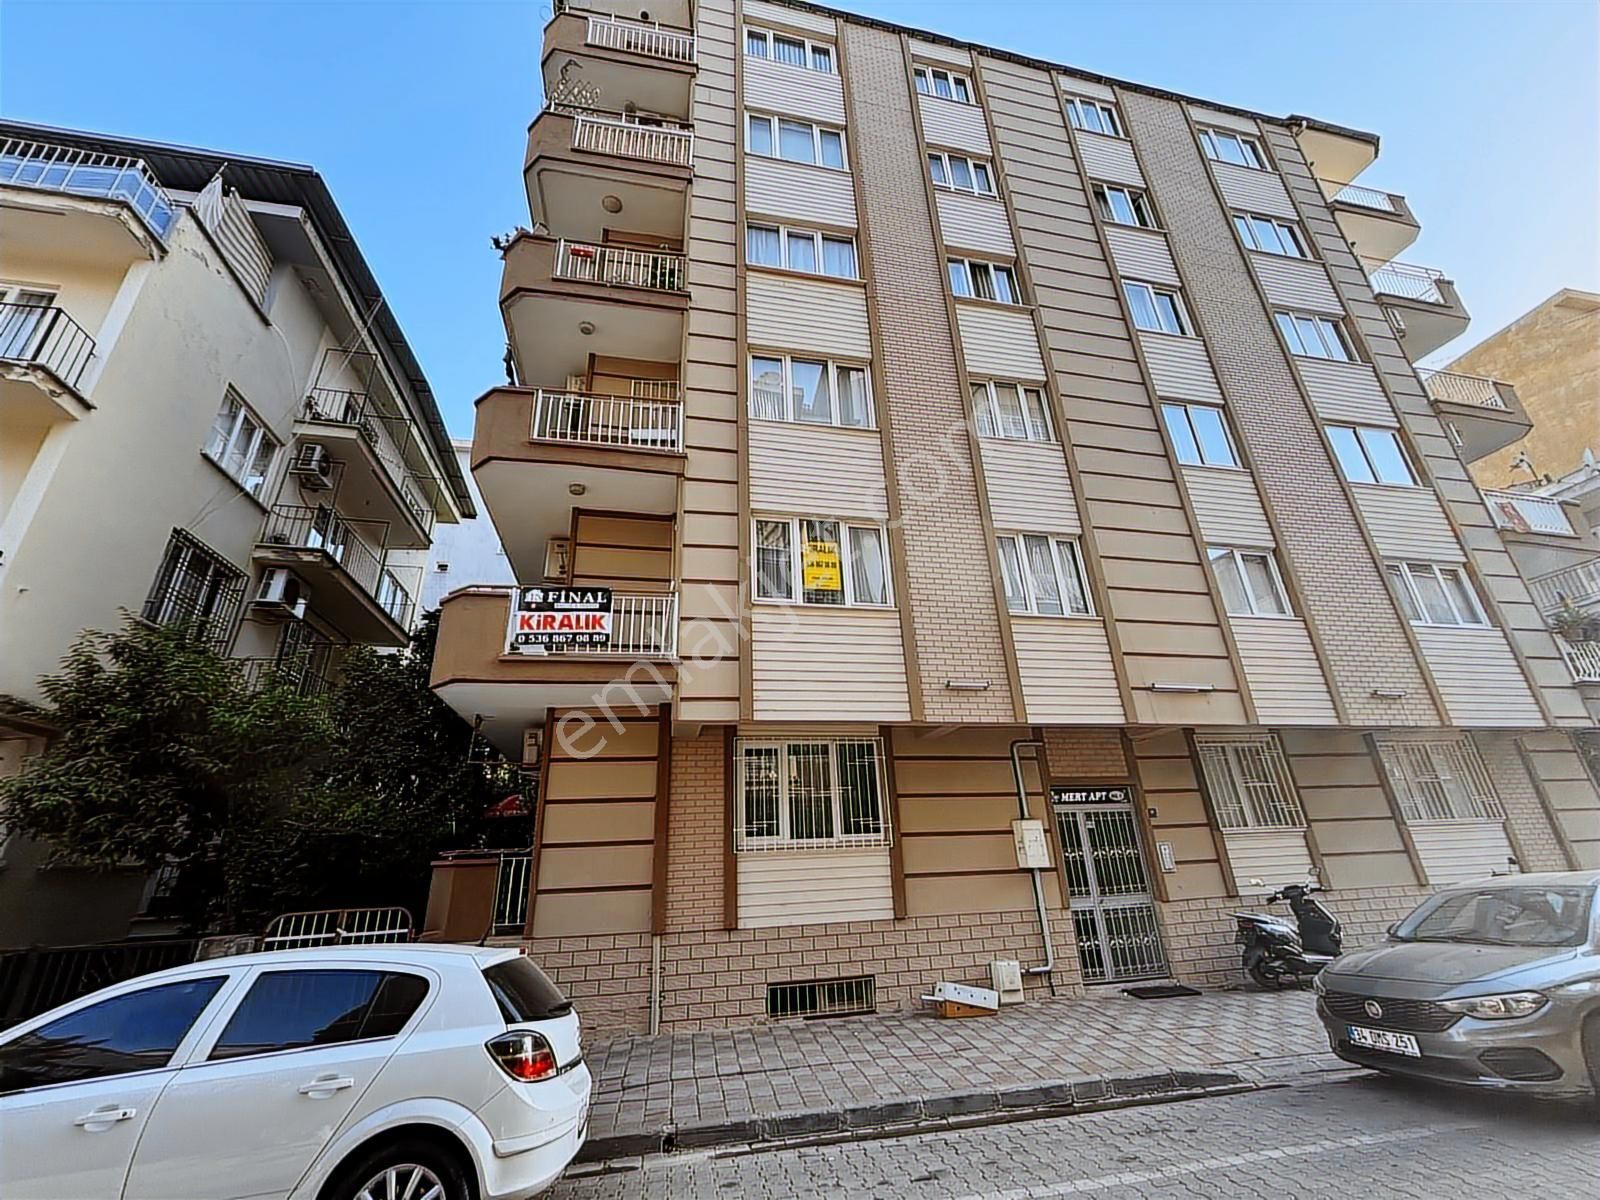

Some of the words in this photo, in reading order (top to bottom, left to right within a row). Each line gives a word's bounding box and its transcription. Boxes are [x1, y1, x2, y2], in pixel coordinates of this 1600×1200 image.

[518, 634, 525, 643] 0
[528, 634, 549, 643] 536
[1088, 791, 1107, 801] APT
[1354, 1028, 1368, 1042] 34
[1392, 1034, 1415, 1051] 251
